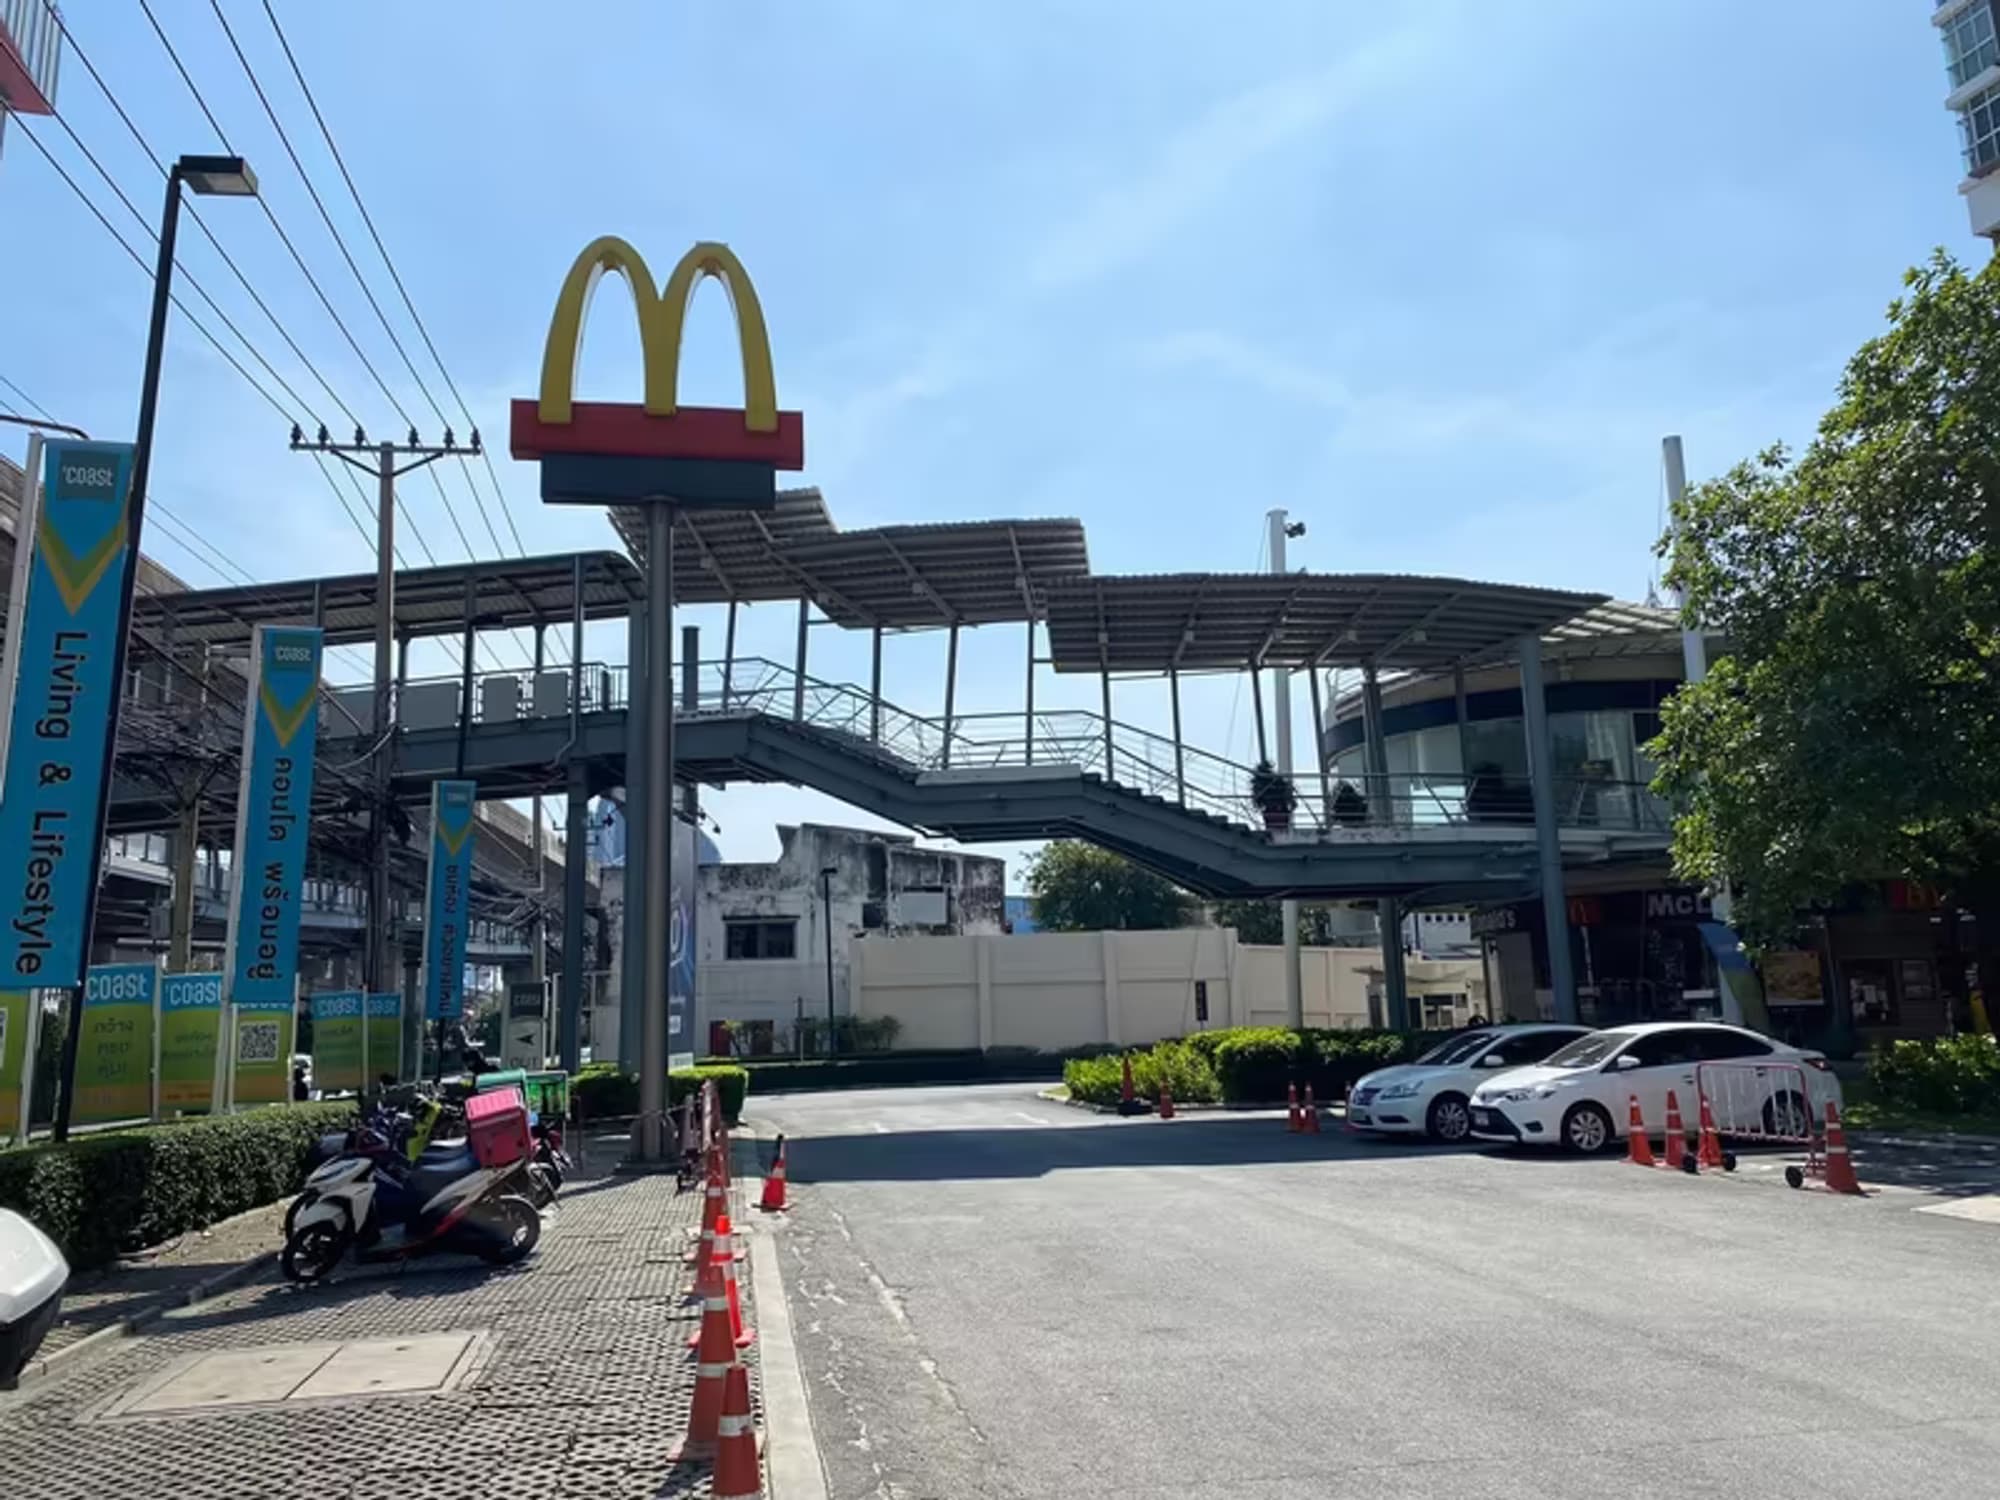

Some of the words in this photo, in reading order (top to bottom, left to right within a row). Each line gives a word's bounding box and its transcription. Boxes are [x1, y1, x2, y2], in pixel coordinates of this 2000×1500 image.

[35, 631, 89, 739] Living
[38, 761, 72, 787] &
[266, 756, 297, 842] คอนโด
[13, 809, 67, 976] Lifestyle
[246, 861, 289, 979] พร้อมอยู่
